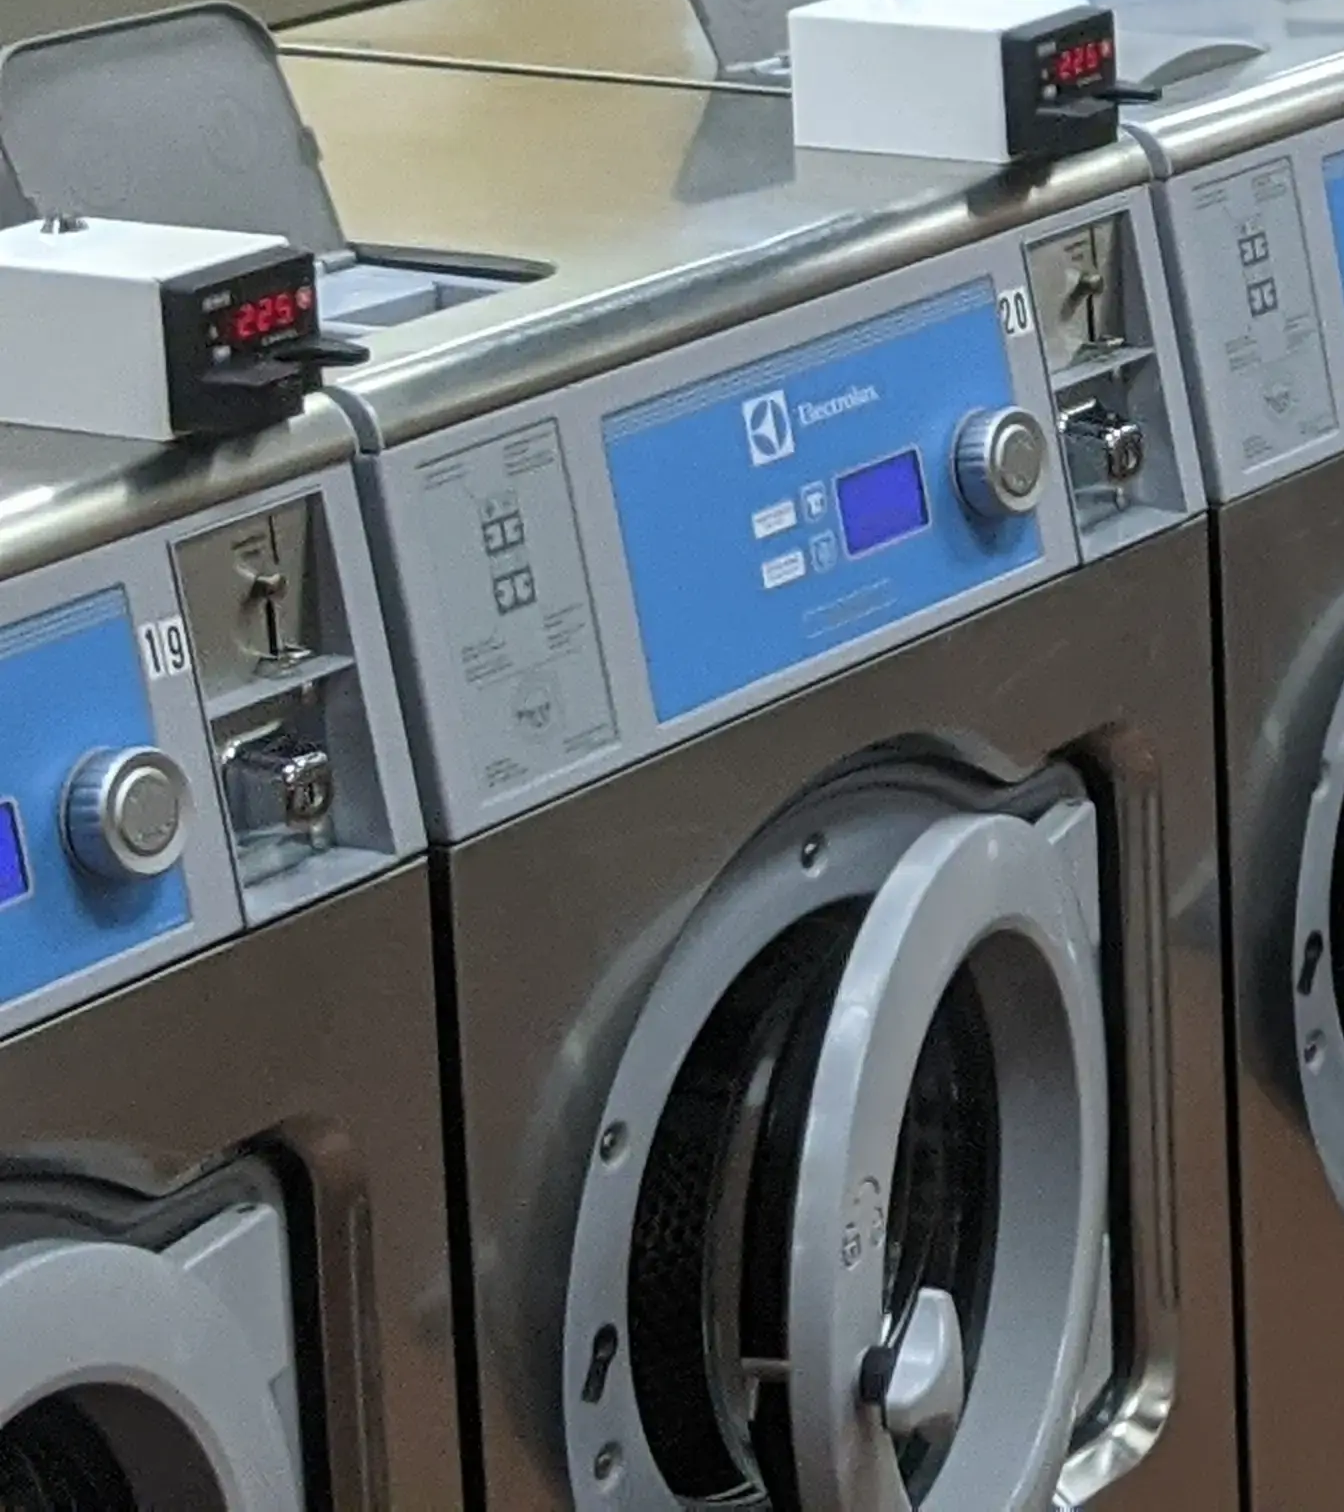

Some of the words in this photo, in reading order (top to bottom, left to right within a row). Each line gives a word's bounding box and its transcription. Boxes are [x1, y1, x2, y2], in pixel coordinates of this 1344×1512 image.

[999, 291, 1028, 335] 20
[798, 384, 881, 427] Electrolux
[145, 626, 185, 673] 19
